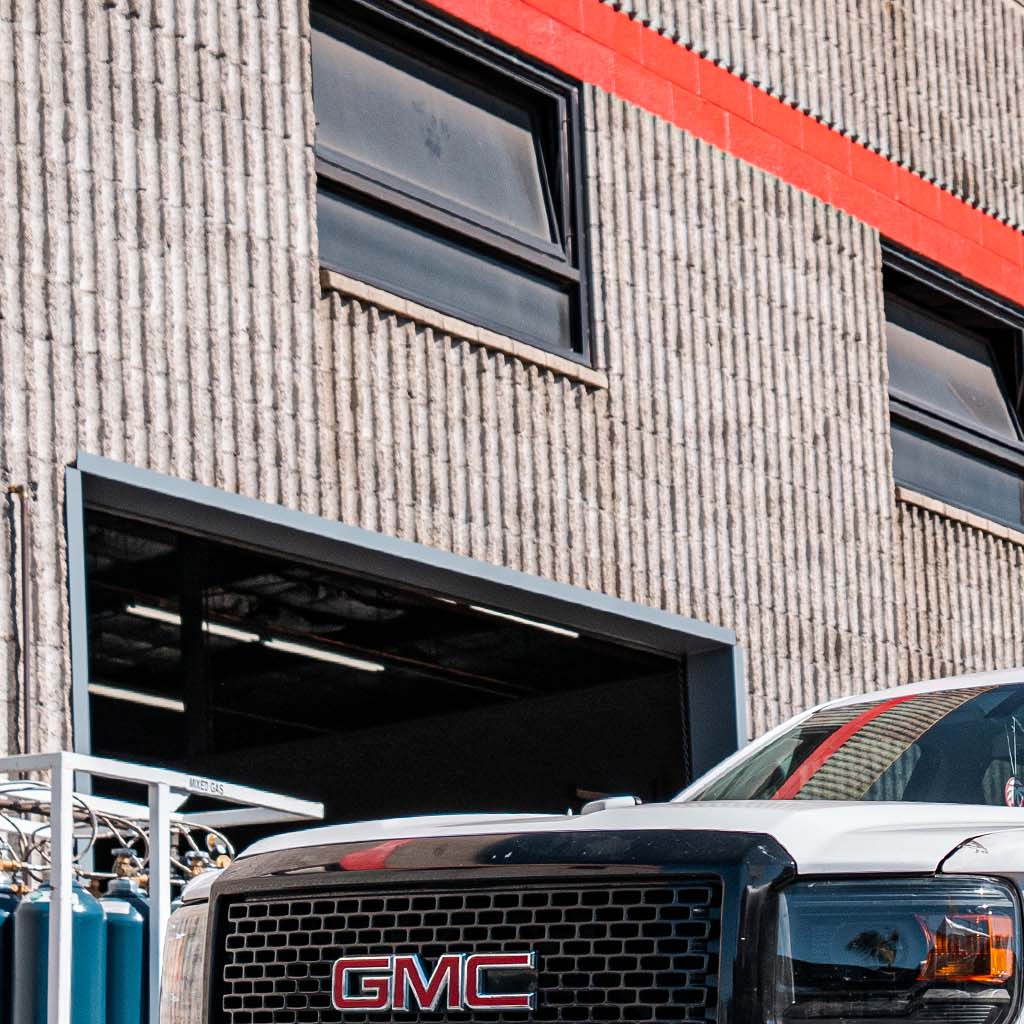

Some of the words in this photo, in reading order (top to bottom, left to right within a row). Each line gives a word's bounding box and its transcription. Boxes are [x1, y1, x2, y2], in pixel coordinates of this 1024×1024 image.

[189, 777, 209, 791] MIXED
[210, 782, 224, 795] GAS
[332, 952, 537, 1011] GMC
